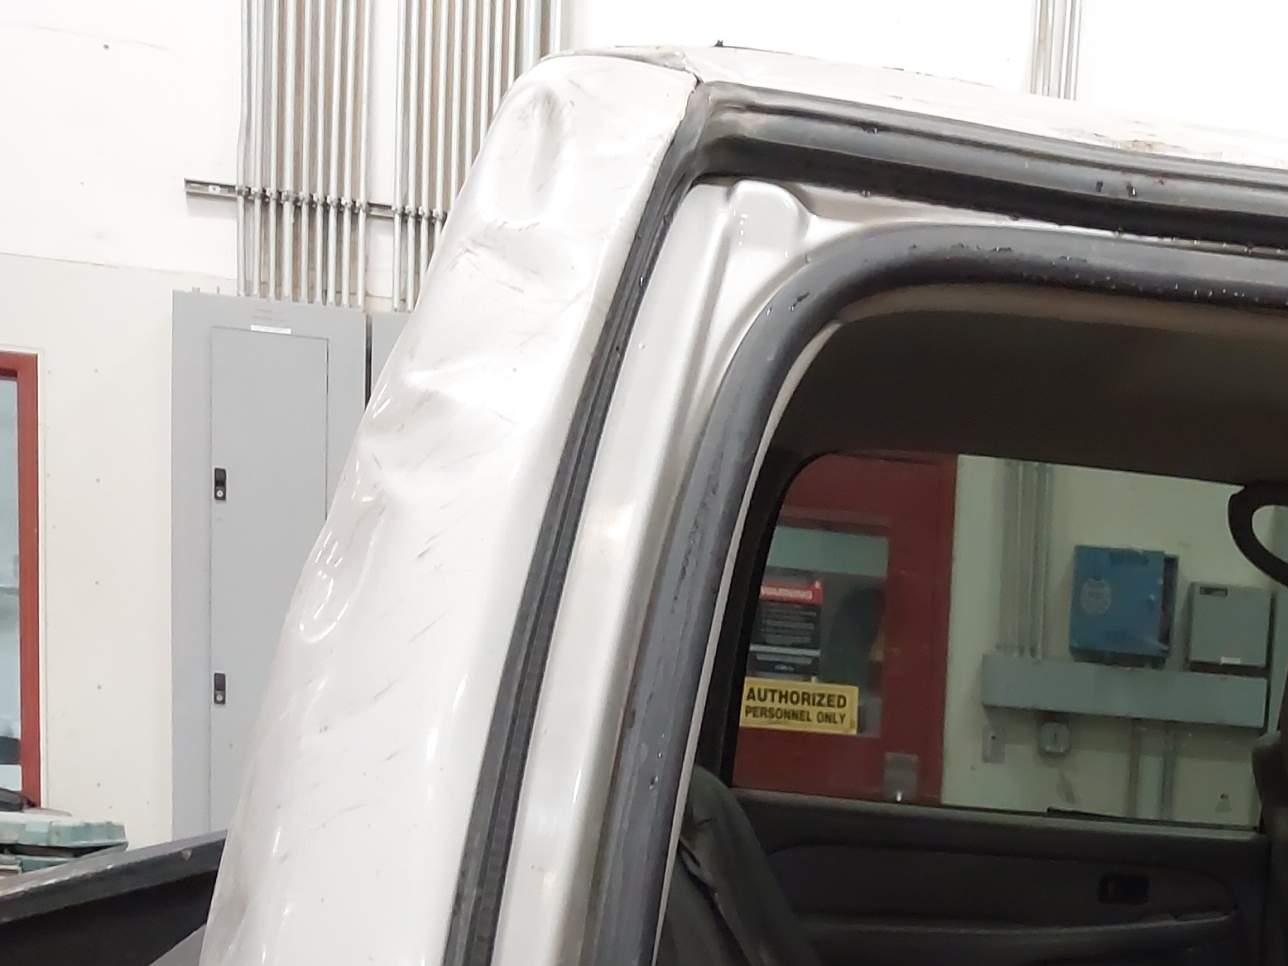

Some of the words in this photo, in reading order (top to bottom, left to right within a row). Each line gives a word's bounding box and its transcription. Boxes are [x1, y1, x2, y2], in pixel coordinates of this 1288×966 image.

[746, 687, 847, 708] AUTHORIZED
[744, 705, 812, 722] PERSONNEL
[816, 711, 846, 725] ONLY
